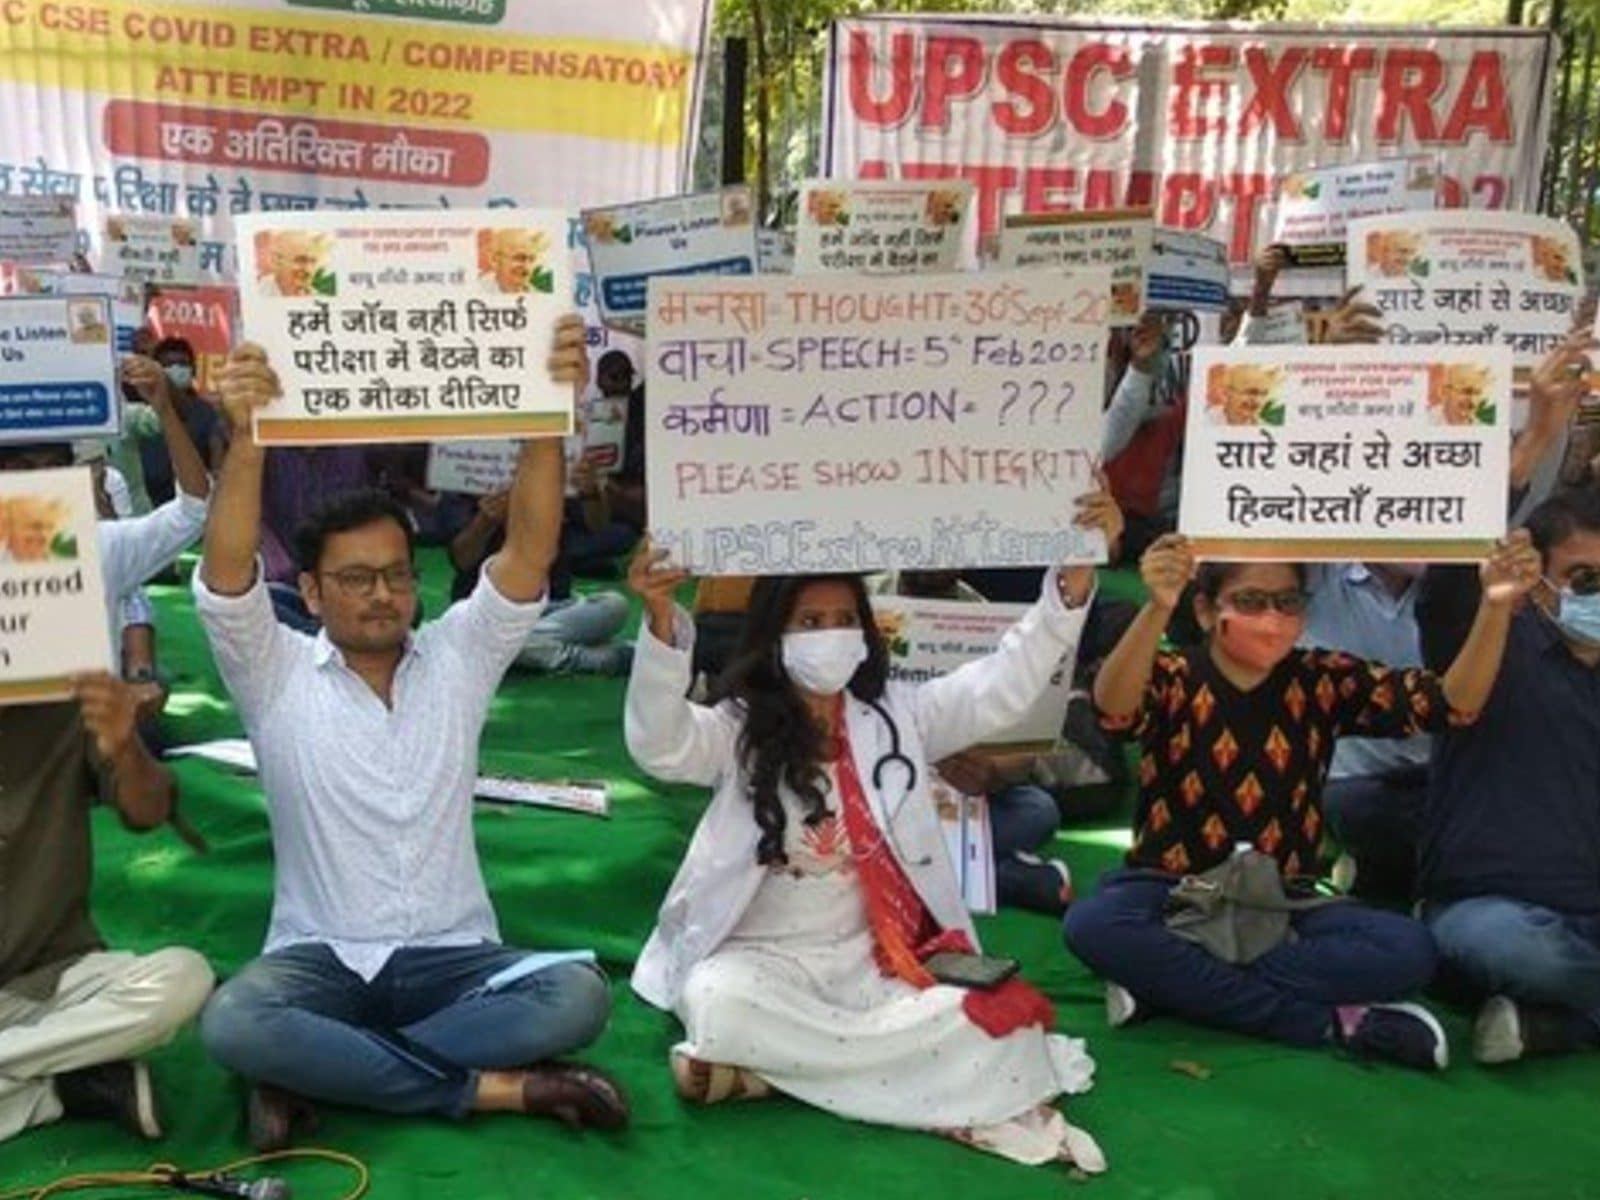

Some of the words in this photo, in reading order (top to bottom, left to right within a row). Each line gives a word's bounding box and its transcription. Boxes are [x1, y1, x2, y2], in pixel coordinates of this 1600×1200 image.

[40, 6, 110, 37] CSE
[122, 16, 237, 50] COVID
[249, 26, 370, 64] EXTRA
[403, 42, 686, 91] COMPENSATORY
[155, 65, 326, 109] ATTEMPT
[339, 84, 374, 112] IN
[389, 88, 473, 121] 2022
[850, 30, 1132, 139] UPSC
[1173, 43, 1512, 142] EXTRA
[161, 122, 216, 156] एक
[224, 119, 365, 169] अतिरिक्त
[371, 133, 456, 179] मौका
[186, 173, 222, 218] के
[287, 298, 331, 339] हमें
[342, 298, 399, 334] जॉब
[407, 298, 458, 338] नहीं
[467, 296, 528, 332] सिर्फ
[1376, 280, 1425, 312] सारे
[1434, 282, 1482, 315] जहां
[1491, 279, 1512, 311] से
[15, 325, 67, 342] Listen
[293, 339, 378, 375] परीक्षा
[386, 337, 410, 373] में
[420, 337, 480, 373] बैठने
[488, 346, 525, 370] का
[303, 386, 350, 414] एक
[359, 378, 431, 410] मौका
[439, 377, 522, 410] दीजिए
[1216, 430, 1278, 469] सारे
[1288, 433, 1351, 474] जहां
[1363, 429, 1391, 469] से
[1402, 441, 1483, 469] अच्छा
[675, 462, 801, 500] PLEASE
[815, 459, 901, 487] SHOW
[1227, 484, 1372, 527] हिन्दोस्ताँ
[1374, 495, 1465, 529] हमारा
